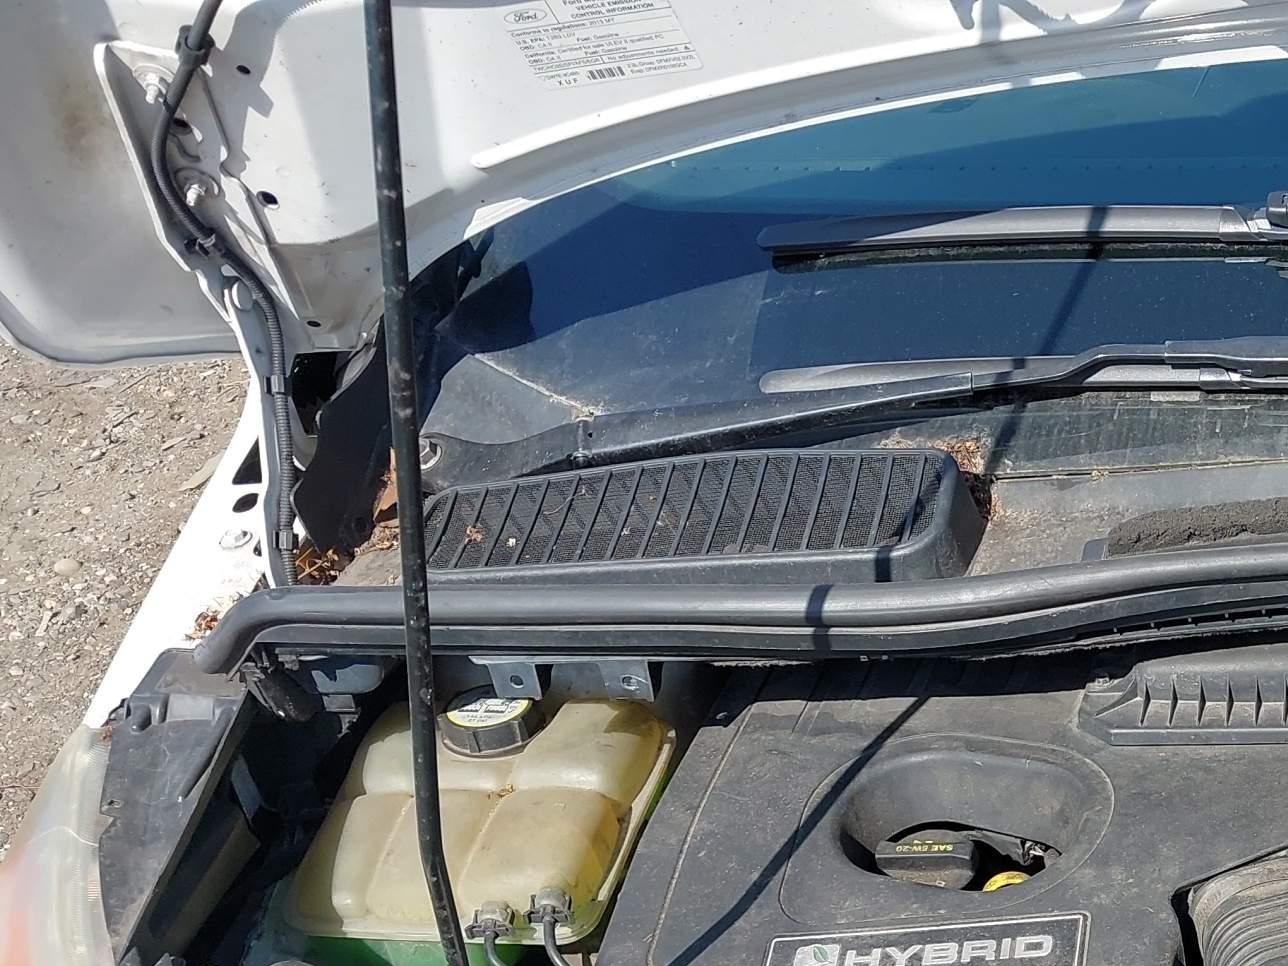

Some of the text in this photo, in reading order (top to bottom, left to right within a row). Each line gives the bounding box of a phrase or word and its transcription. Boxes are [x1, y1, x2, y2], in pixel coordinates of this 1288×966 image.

[571, 3, 654, 19] CONTROL INFORMATION
[575, 2, 606, 11] VEHICLE
[513, 11, 538, 22] Ford
[896, 844, 954, 852] SAE 5W-20
